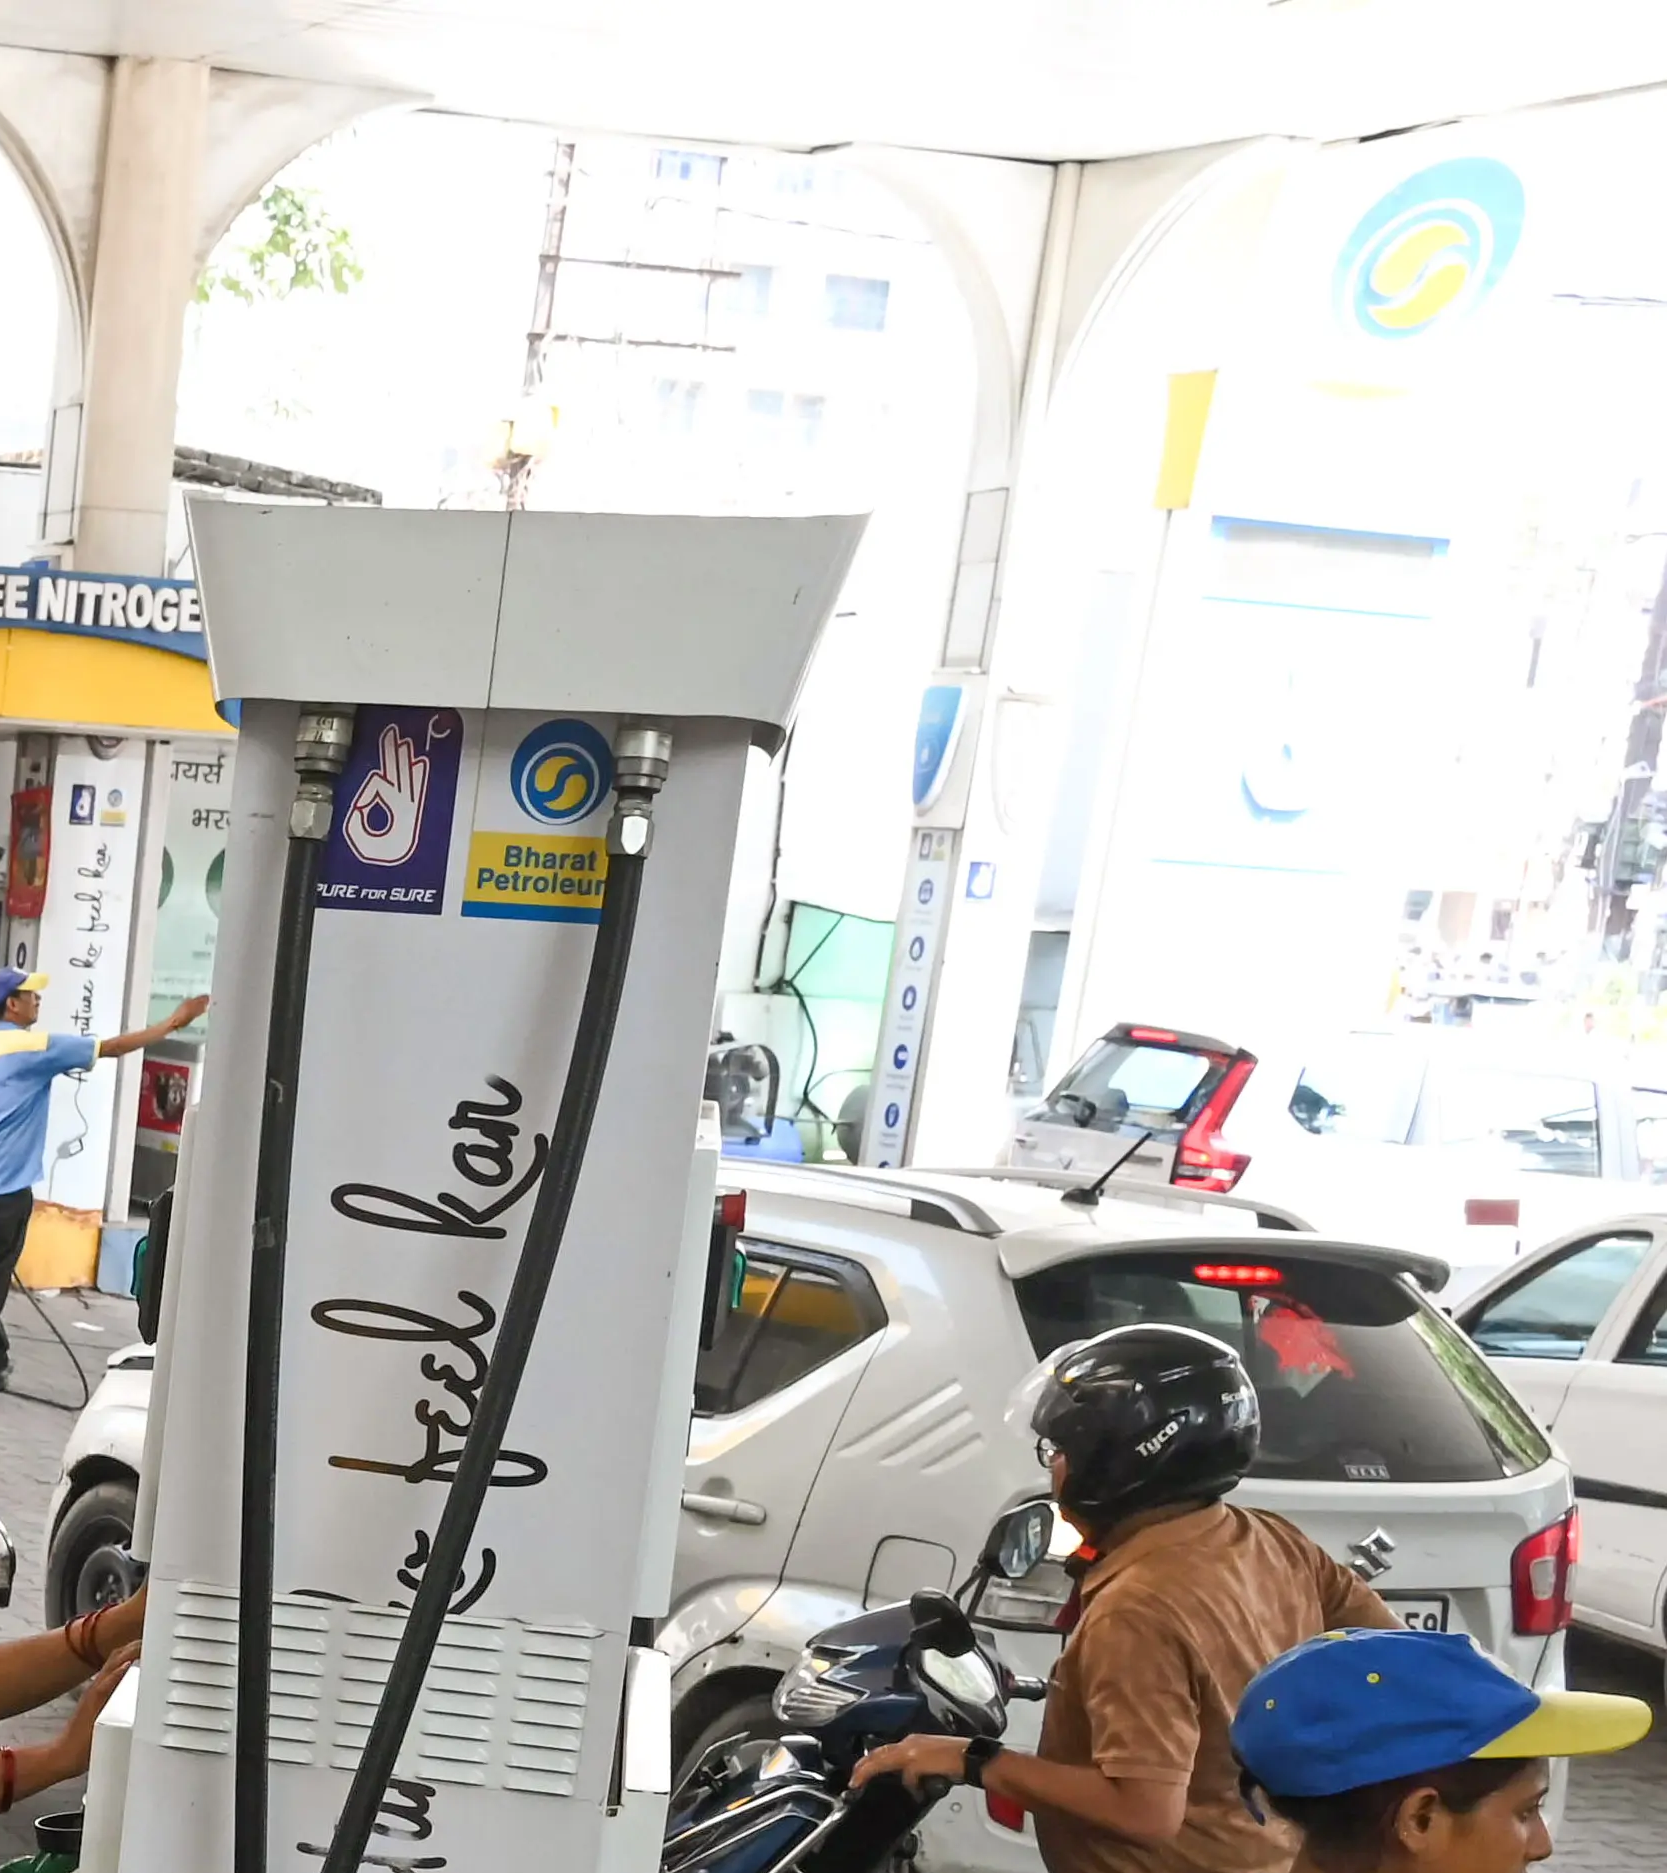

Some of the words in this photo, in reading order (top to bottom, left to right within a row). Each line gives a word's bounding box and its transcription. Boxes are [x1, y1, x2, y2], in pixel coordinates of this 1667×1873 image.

[36, 576, 203, 633] NITROGE
[171, 754, 226, 783] ायर्स
[192, 808, 230, 830] भर
[504, 844, 597, 871] Bharat
[74, 890, 109, 932] feel
[360, 888, 387, 900] FOR
[389, 887, 437, 903] SURE
[69, 943, 103, 968] ko
[71, 979, 97, 1037] uture
[311, 1291, 548, 1488] feel
[1135, 1420, 1179, 1457] Tyco
